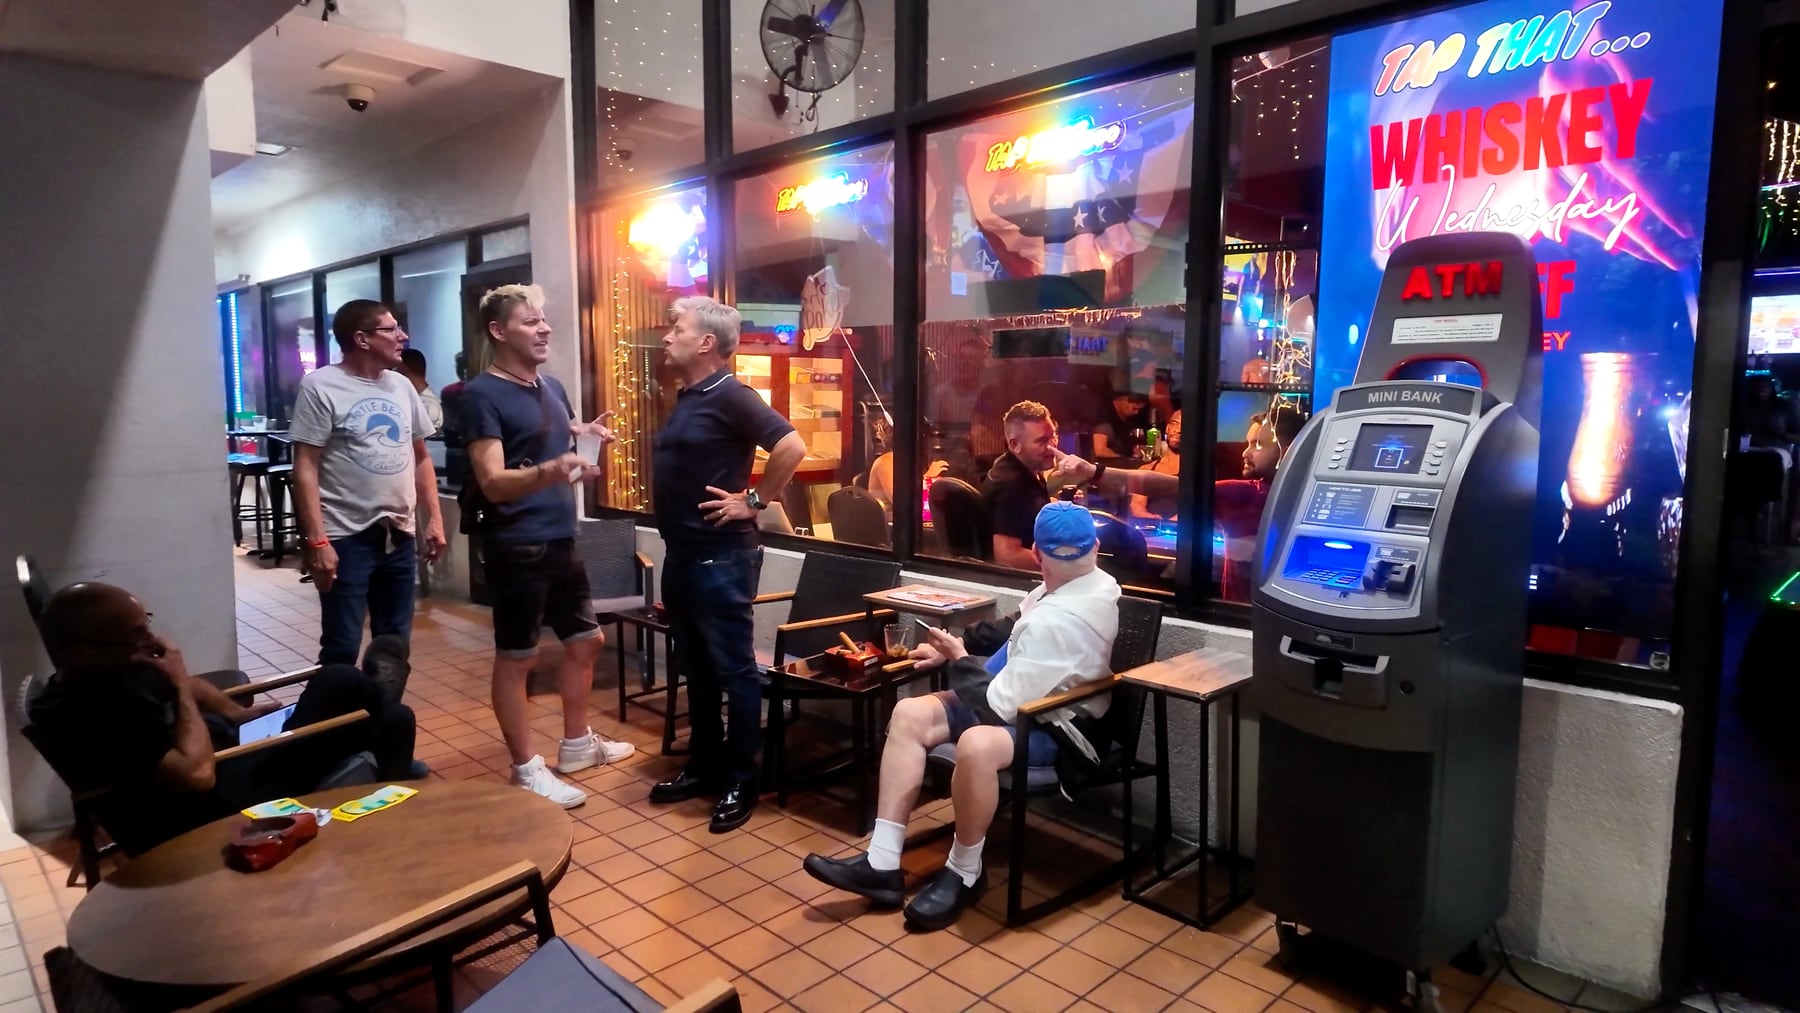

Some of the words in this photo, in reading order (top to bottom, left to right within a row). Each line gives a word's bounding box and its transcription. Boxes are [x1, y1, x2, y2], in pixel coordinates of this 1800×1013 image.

[1374, 32, 1466, 97] TAP
[1467, 1, 1651, 79] THAT...
[1370, 78, 1654, 191] WHISKEY
[1376, 164, 1640, 251] Wednesday
[1401, 260, 1504, 301] ATM
[349, 402, 378, 435] MYRTLE
[1368, 390, 1398, 404] MINI
[1401, 390, 1443, 404] BANK
